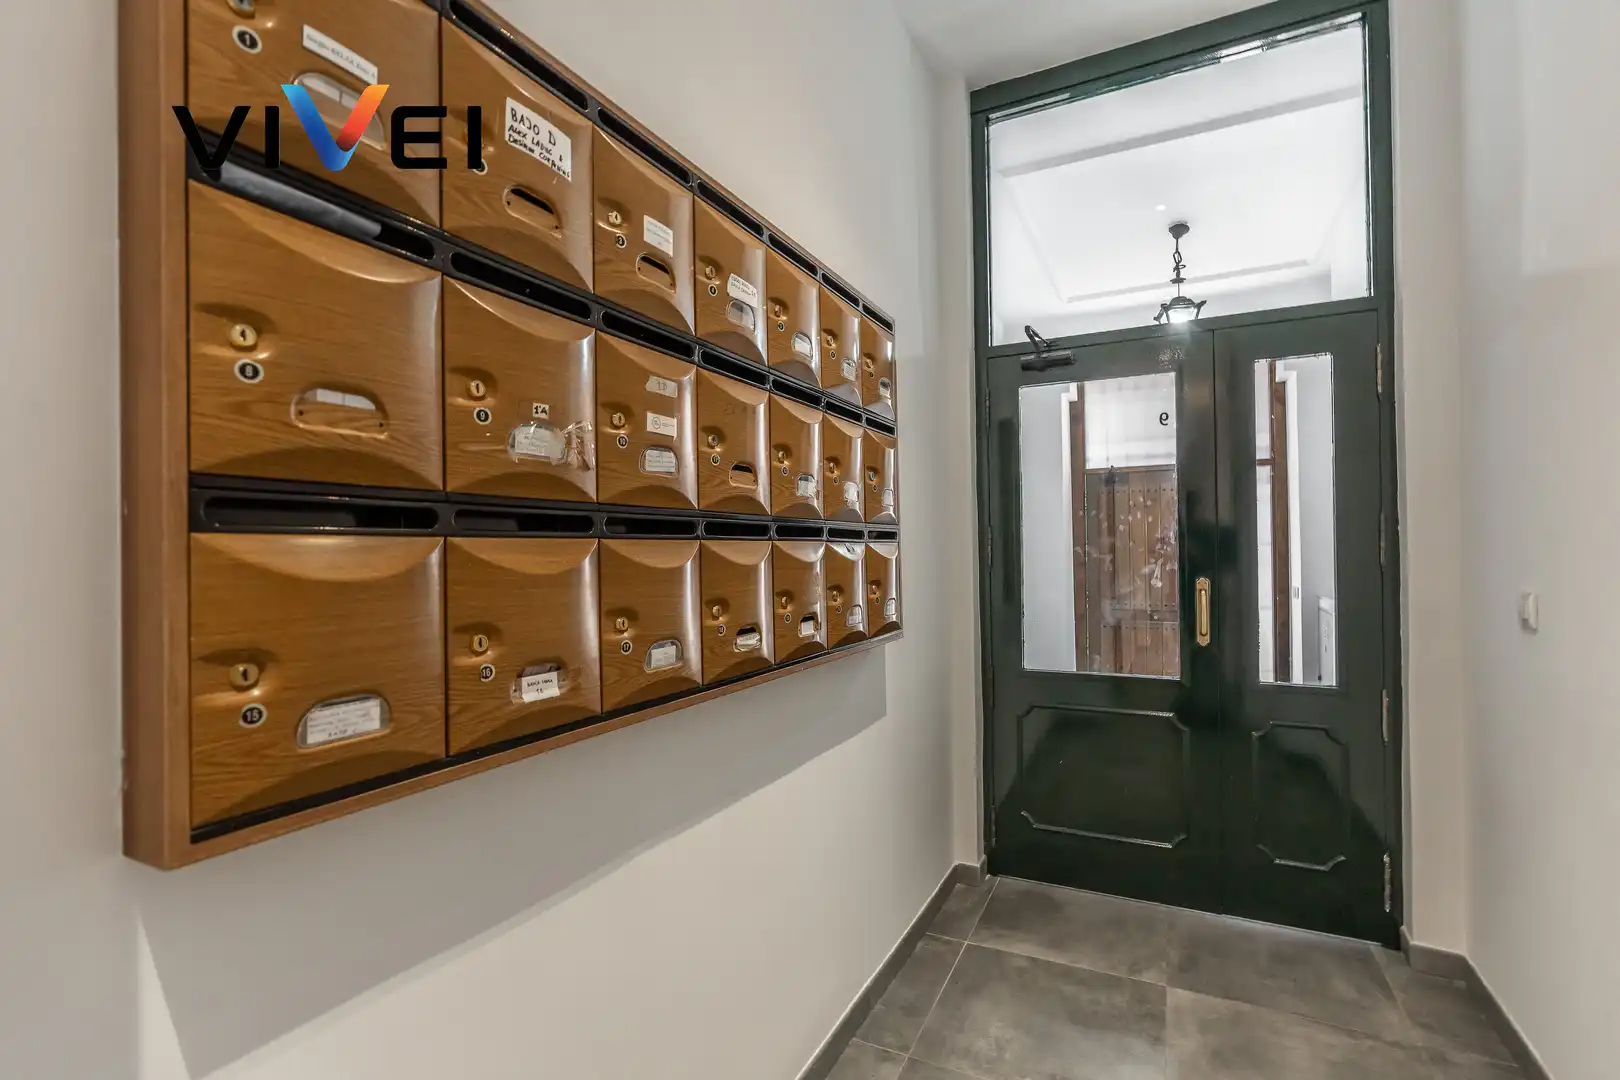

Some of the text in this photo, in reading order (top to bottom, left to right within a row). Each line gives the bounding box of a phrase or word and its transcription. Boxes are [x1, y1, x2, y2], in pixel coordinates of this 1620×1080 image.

[510, 107, 556, 147] BAJO D
[246, 710, 259, 722] 15
